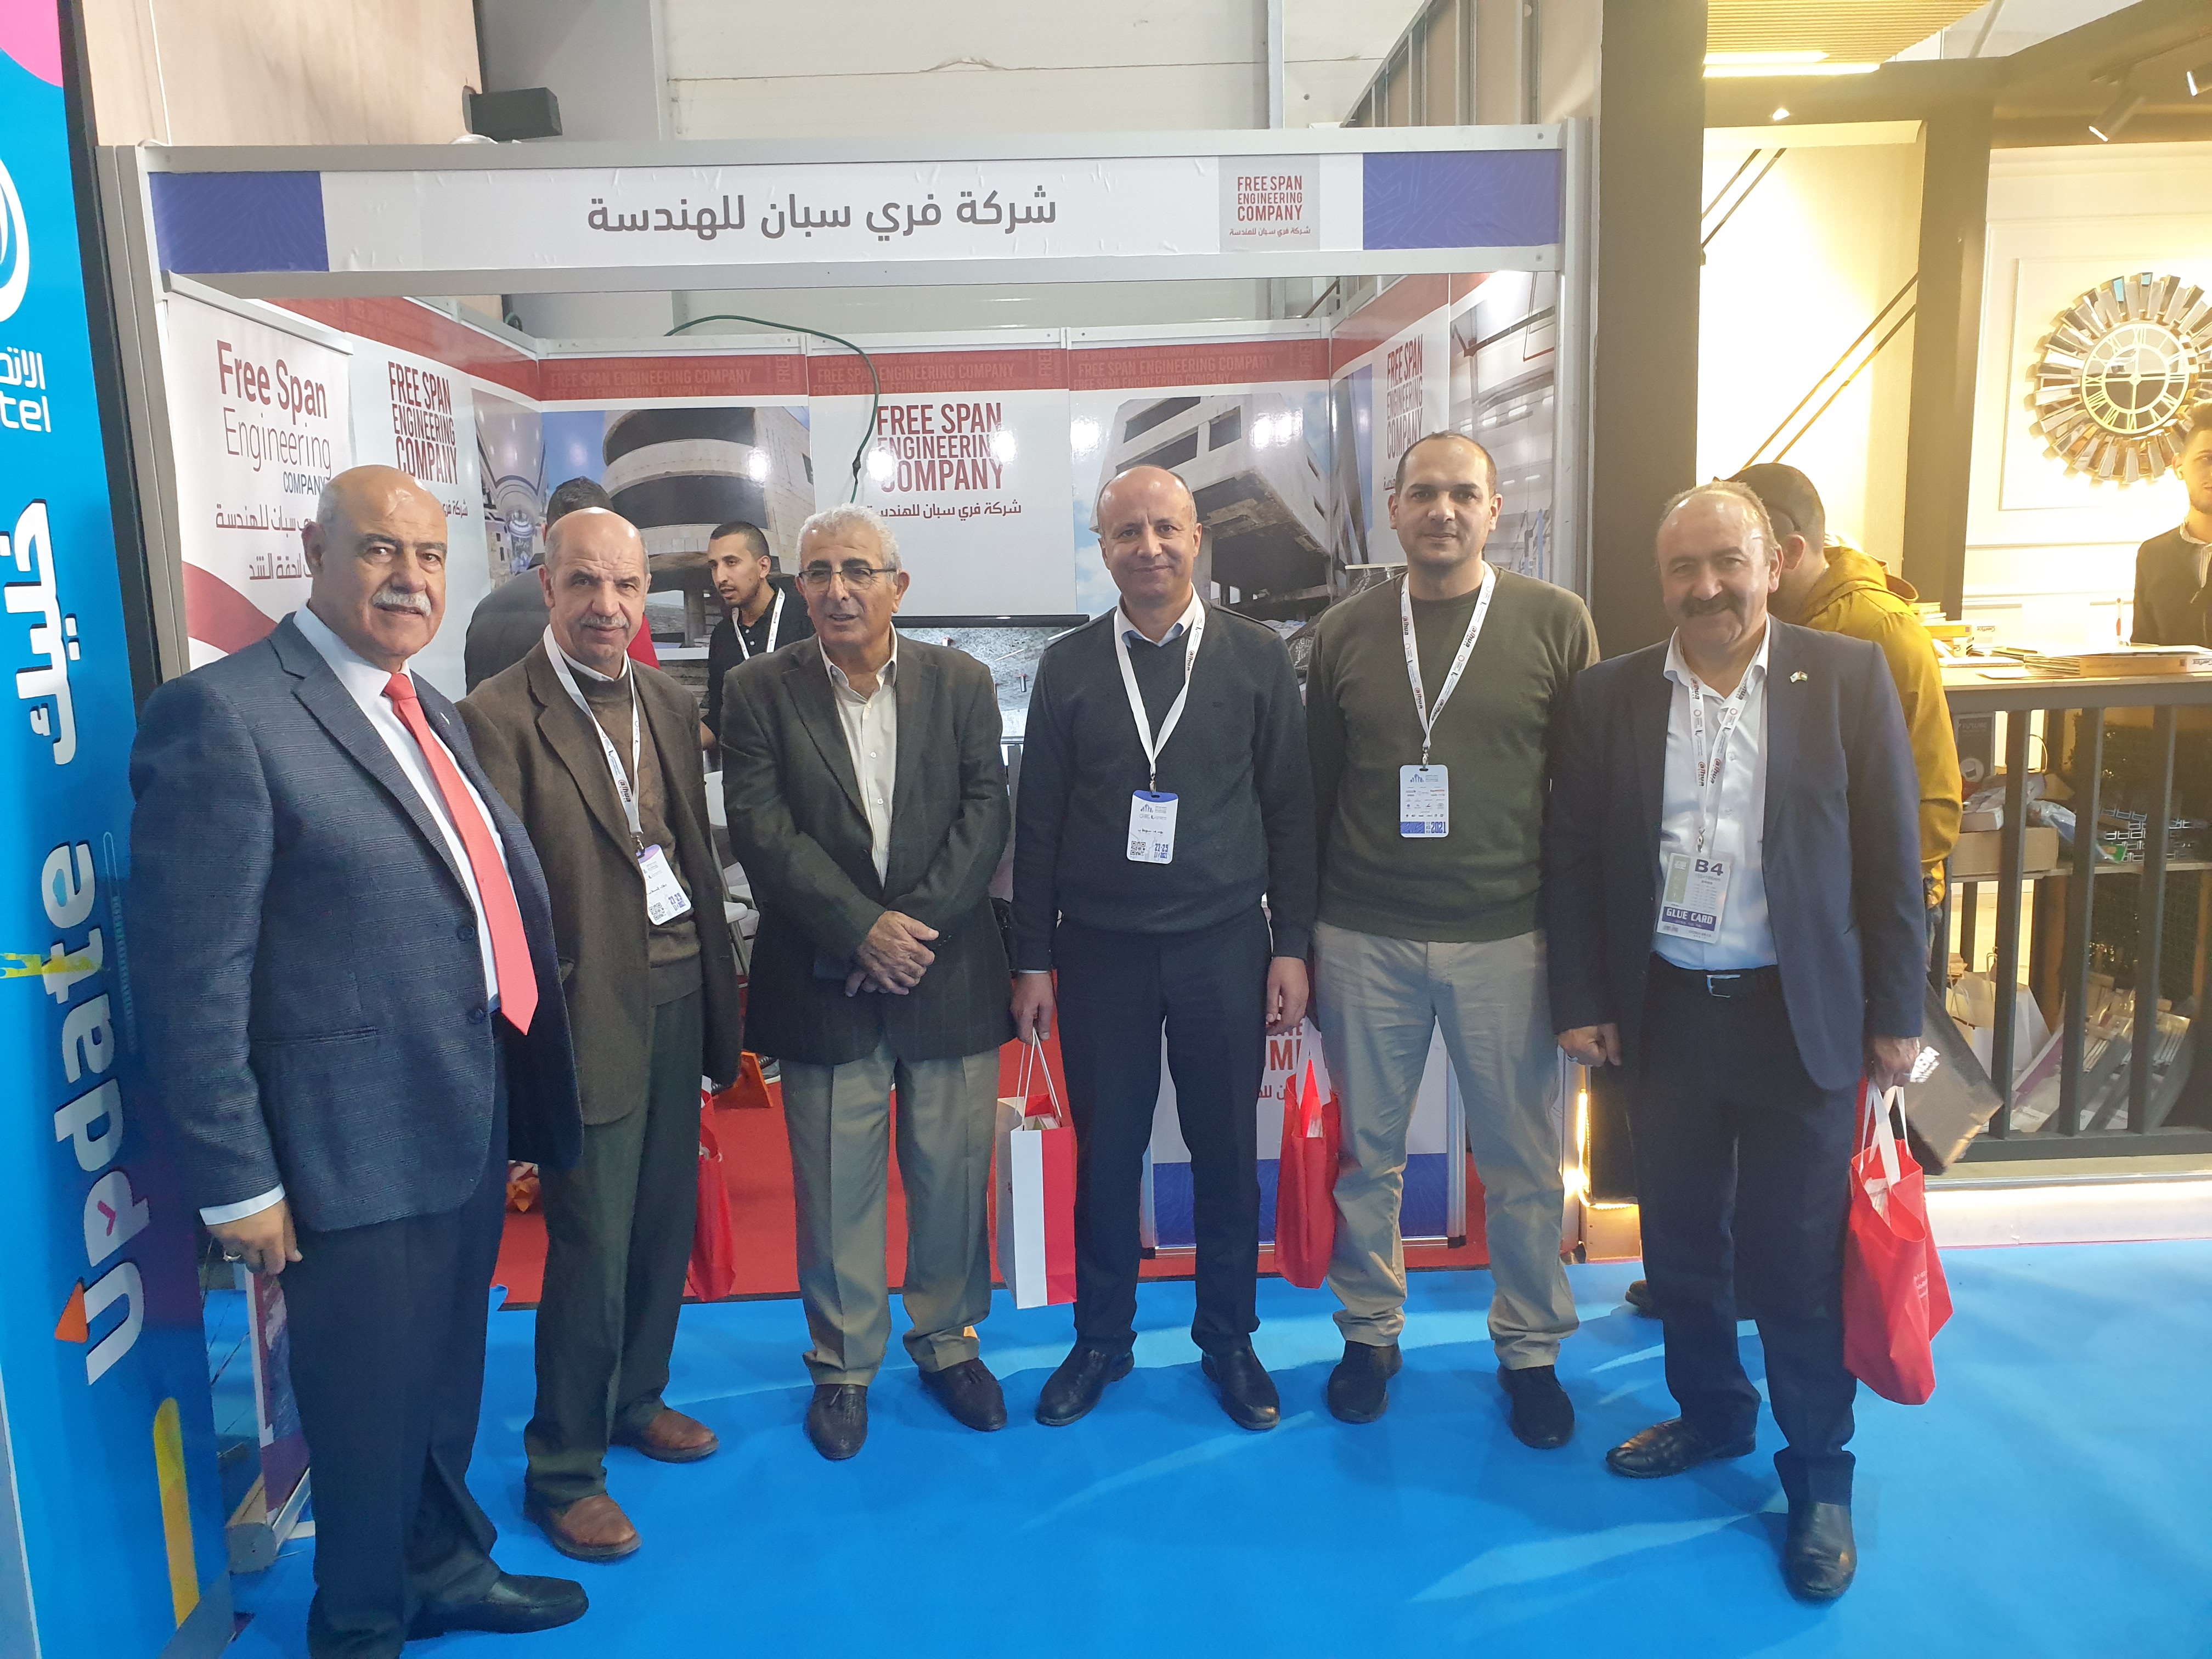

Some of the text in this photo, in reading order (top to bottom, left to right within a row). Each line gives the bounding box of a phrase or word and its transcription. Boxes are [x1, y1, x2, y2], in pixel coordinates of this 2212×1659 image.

[1238, 175, 1303, 191] FREE SPAN
[1238, 192, 1303, 205] ENGINEERING
[587, 185, 1057, 241] شركة فري سبان للهندسة
[1237, 205, 1303, 222] COMPANY
[1229, 225, 1311, 237] شركة فري سبان للهندسة
[776, 356, 791, 383] FREE
[817, 368, 844, 382] FREE
[879, 364, 955, 381] ENGINEERING
[958, 363, 1015, 379] COMPANY
[1039, 349, 1052, 377] FREE
[1079, 362, 1105, 377] FREE
[1108, 361, 1136, 376] SPAN
[1139, 358, 1216, 375] ENGINEERING
[1218, 355, 1276, 372] COMPANY
[1387, 333, 1423, 390] FREE SPAN
[217, 340, 328, 425] Free Span
[388, 361, 452, 415] FREE SPAN
[551, 368, 752, 387] FREE SPAN ENGINEERING COMPANY
[926, 379, 970, 392] COMPANY
[1185, 373, 1229, 386] COMPANY
[1387, 375, 1423, 421] ENGINEERING
[391, 404, 455, 445] ENGINEERING
[877, 403, 1002, 436] FREE SPAN
[223, 407, 331, 481] Engineering
[877, 434, 994, 460] ENGINEERIN
[1387, 408, 1423, 460] COMPANY
[396, 436, 458, 484] COMPANY
[283, 471, 326, 495] COMPANY
[216, 503, 269, 531] للهندسة
[271, 505, 296, 538] سبان
[453, 499, 468, 518] شركة
[867, 499, 1022, 521] شركة فري سبان للهندس
[0, 498, 81, 765] خليك
[1431, 821, 1447, 834] 2021
[1695, 859, 1724, 876] B4
[1666, 908, 1688, 920] GLUE
[1690, 913, 1713, 924] CARD
[41, 840, 150, 1386] Update
